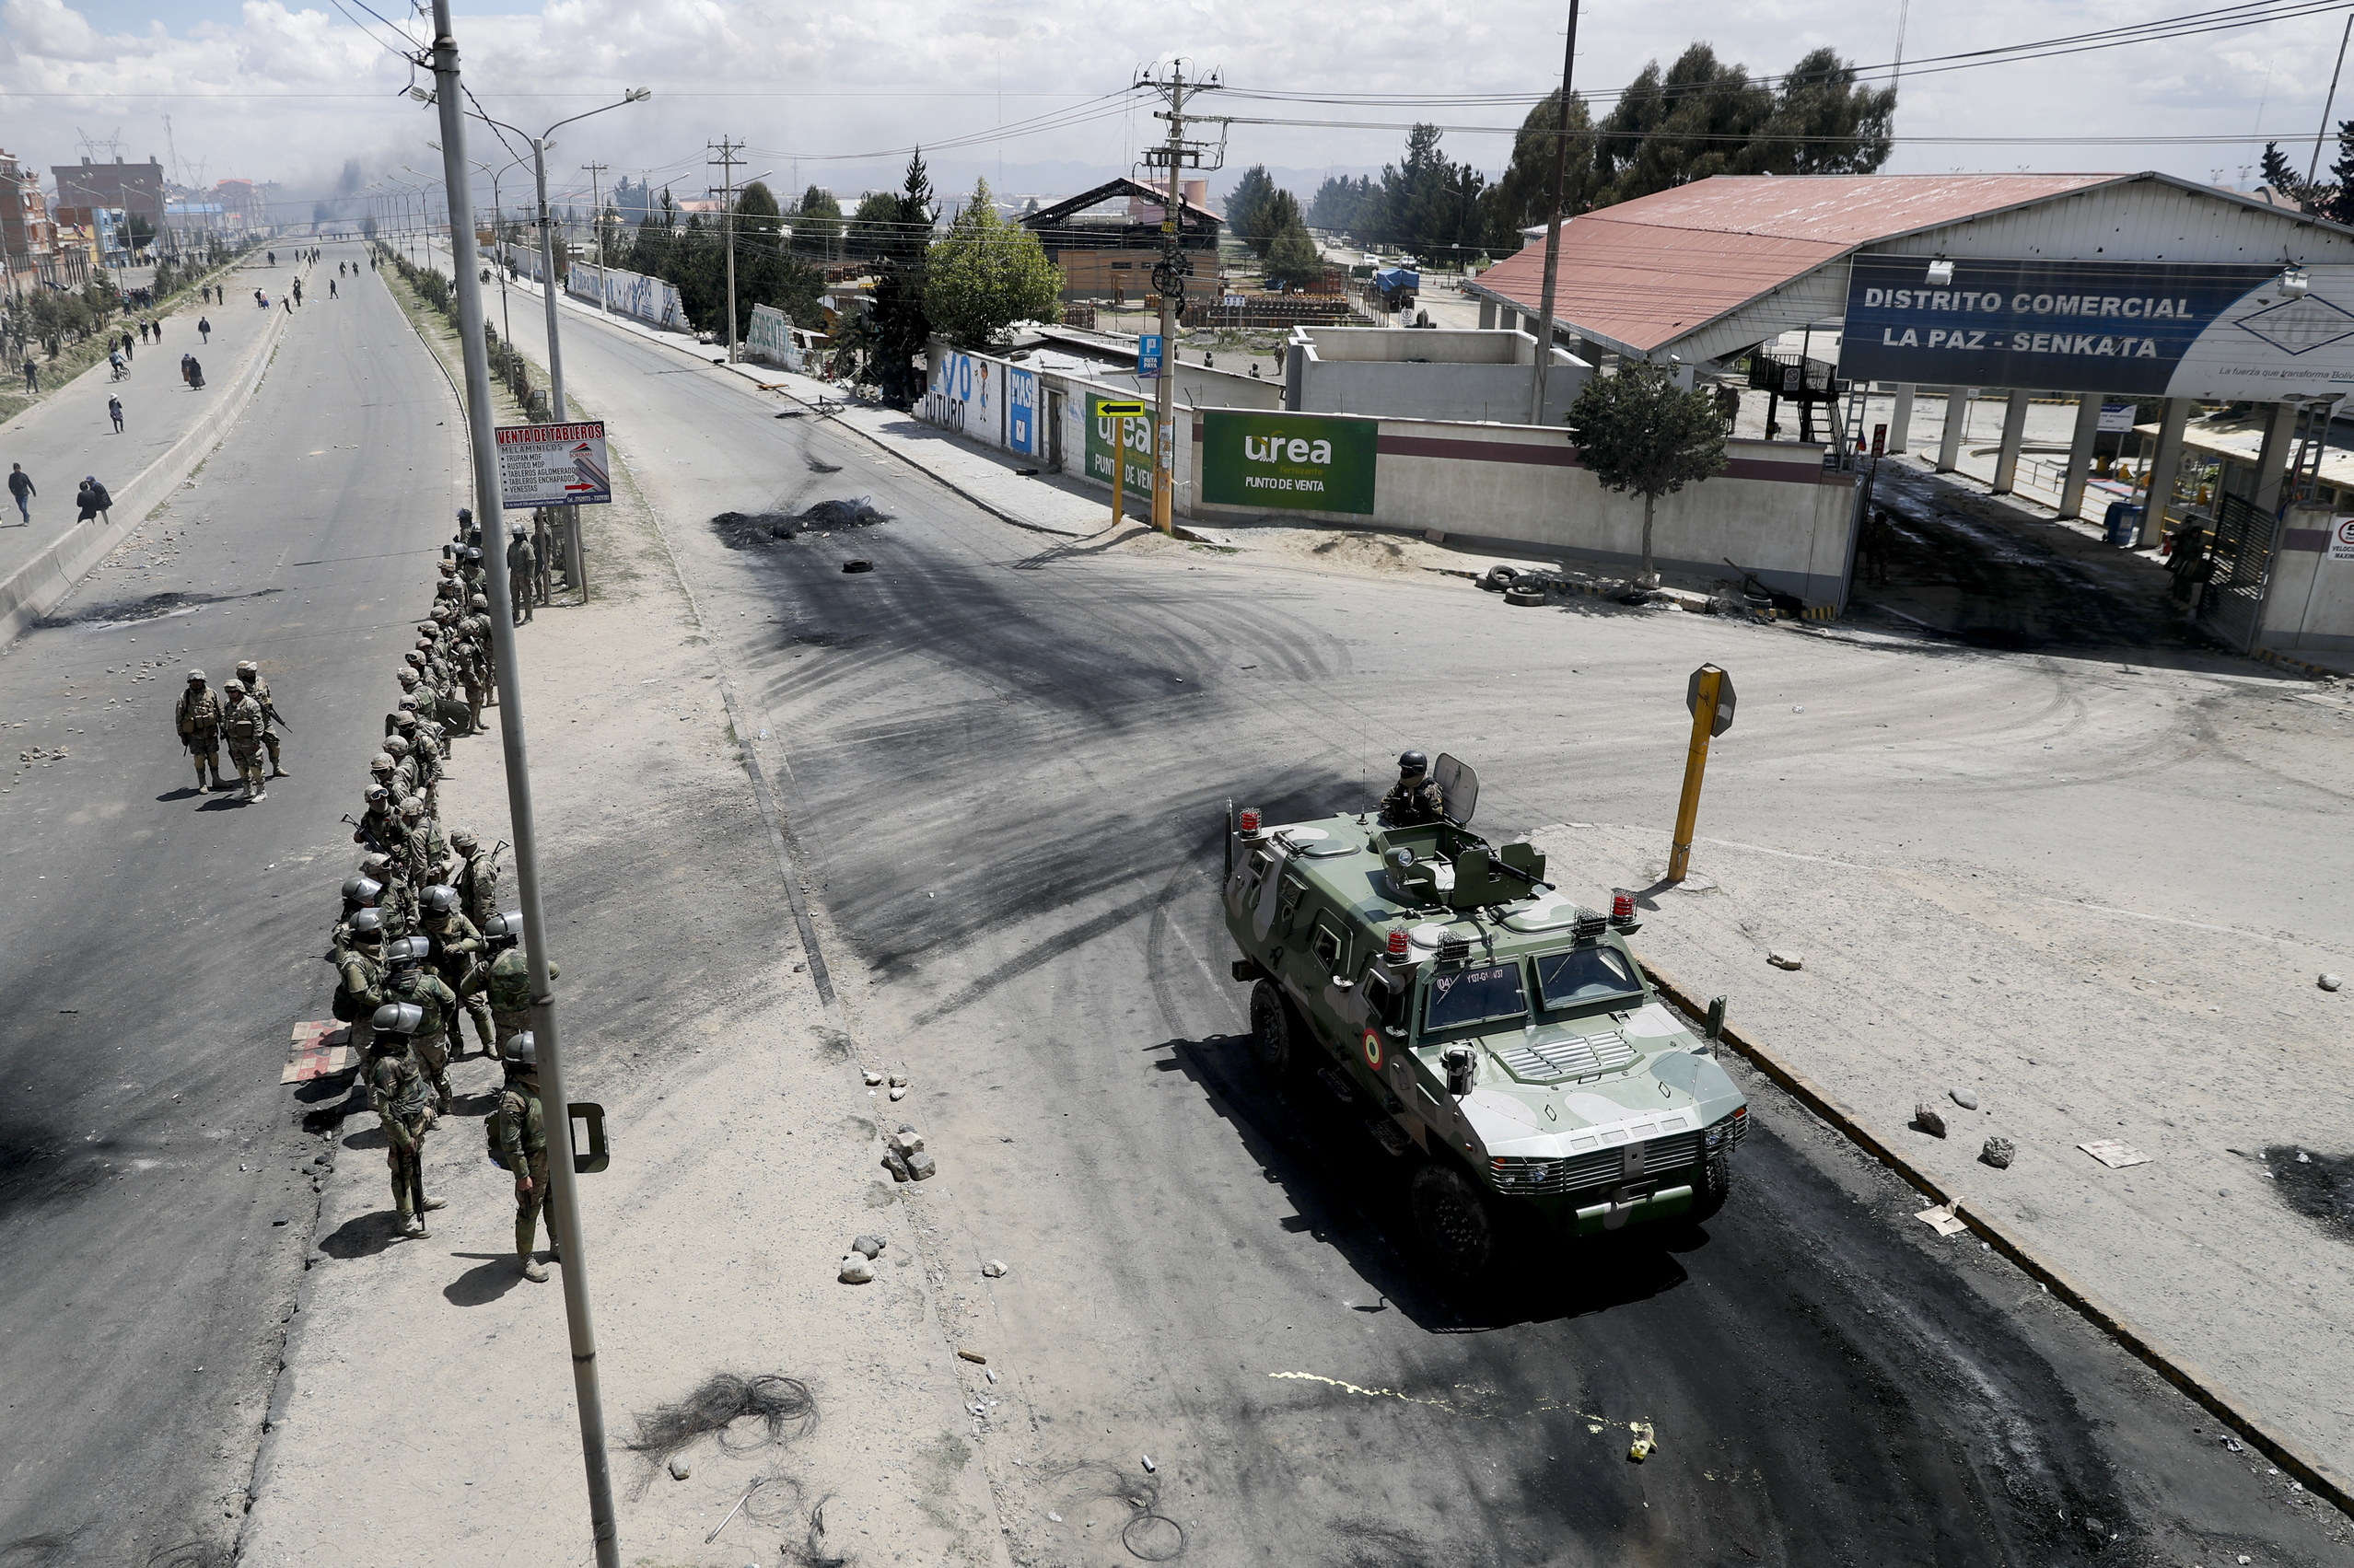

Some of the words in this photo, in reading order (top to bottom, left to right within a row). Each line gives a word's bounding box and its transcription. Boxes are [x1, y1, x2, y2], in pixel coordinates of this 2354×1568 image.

[1864, 287, 2002, 312] DISTRITO
[2011, 293, 2194, 319] COMERCIAL
[1147, 338, 1156, 354] P
[1882, 328, 1918, 348] LA
[1928, 329, 1987, 350] PAZ
[2011, 332, 2157, 358] SENKATA
[2219, 367, 2231, 376] La
[2232, 367, 2260, 377] fuerza
[2262, 370, 2279, 378] que
[2281, 370, 2329, 379] transforma
[2331, 371, 2354, 379] Boliv
[1011, 373, 1032, 408] MAS
[497, 429, 531, 445] VENTA
[533, 428, 547, 443] DE
[549, 424, 602, 441] TABLEROS
[1872, 425, 1885, 458] PARE
[502, 443, 563, 454] MELAMINICOS
[1245, 435, 1332, 465] urea
[507, 454, 528, 462] TRUPAN
[507, 461, 531, 470] RUSTICO
[1095, 453, 1115, 477] PUNT
[508, 469, 537, 478] TABLEROS
[538, 466, 579, 476] AGLOMERADOS
[1125, 463, 1136, 485] DE
[1279, 465, 1323, 476] Fertilizante
[509, 476, 538, 486] TABLEROS
[539, 474, 576, 484] ENCHAPADOS
[1245, 476, 1277, 490] PUNTO
[1278, 478, 1292, 491] DE
[1294, 479, 1324, 493] VENTA
[509, 484, 539, 494] VENESTAS
[1439, 978, 1451, 990] 04
